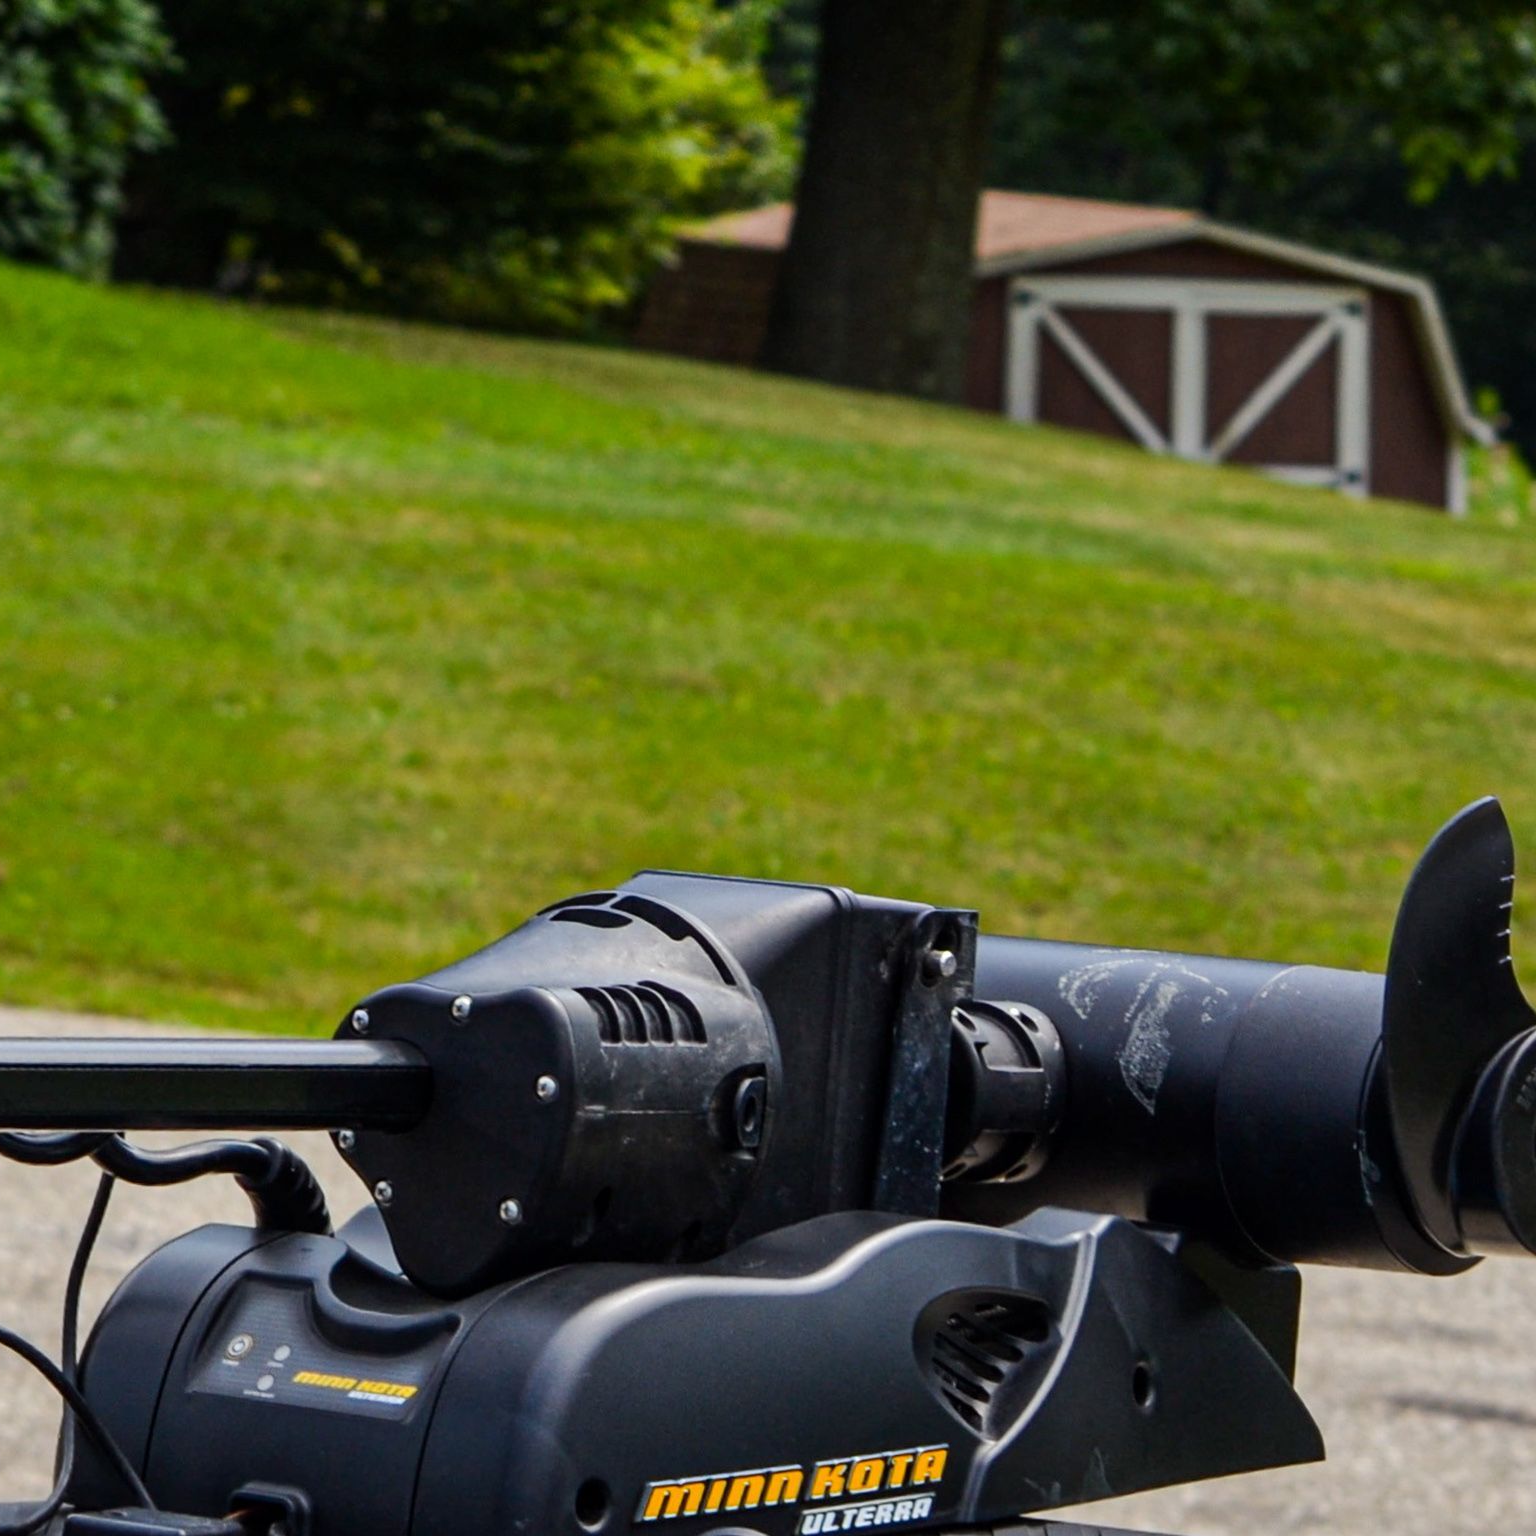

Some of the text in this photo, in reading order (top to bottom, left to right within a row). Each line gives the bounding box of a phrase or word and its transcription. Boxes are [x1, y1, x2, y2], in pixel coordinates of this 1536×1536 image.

[637, 1445, 949, 1521] MINN KOTA
[799, 1495, 935, 1536] ULTERRA
